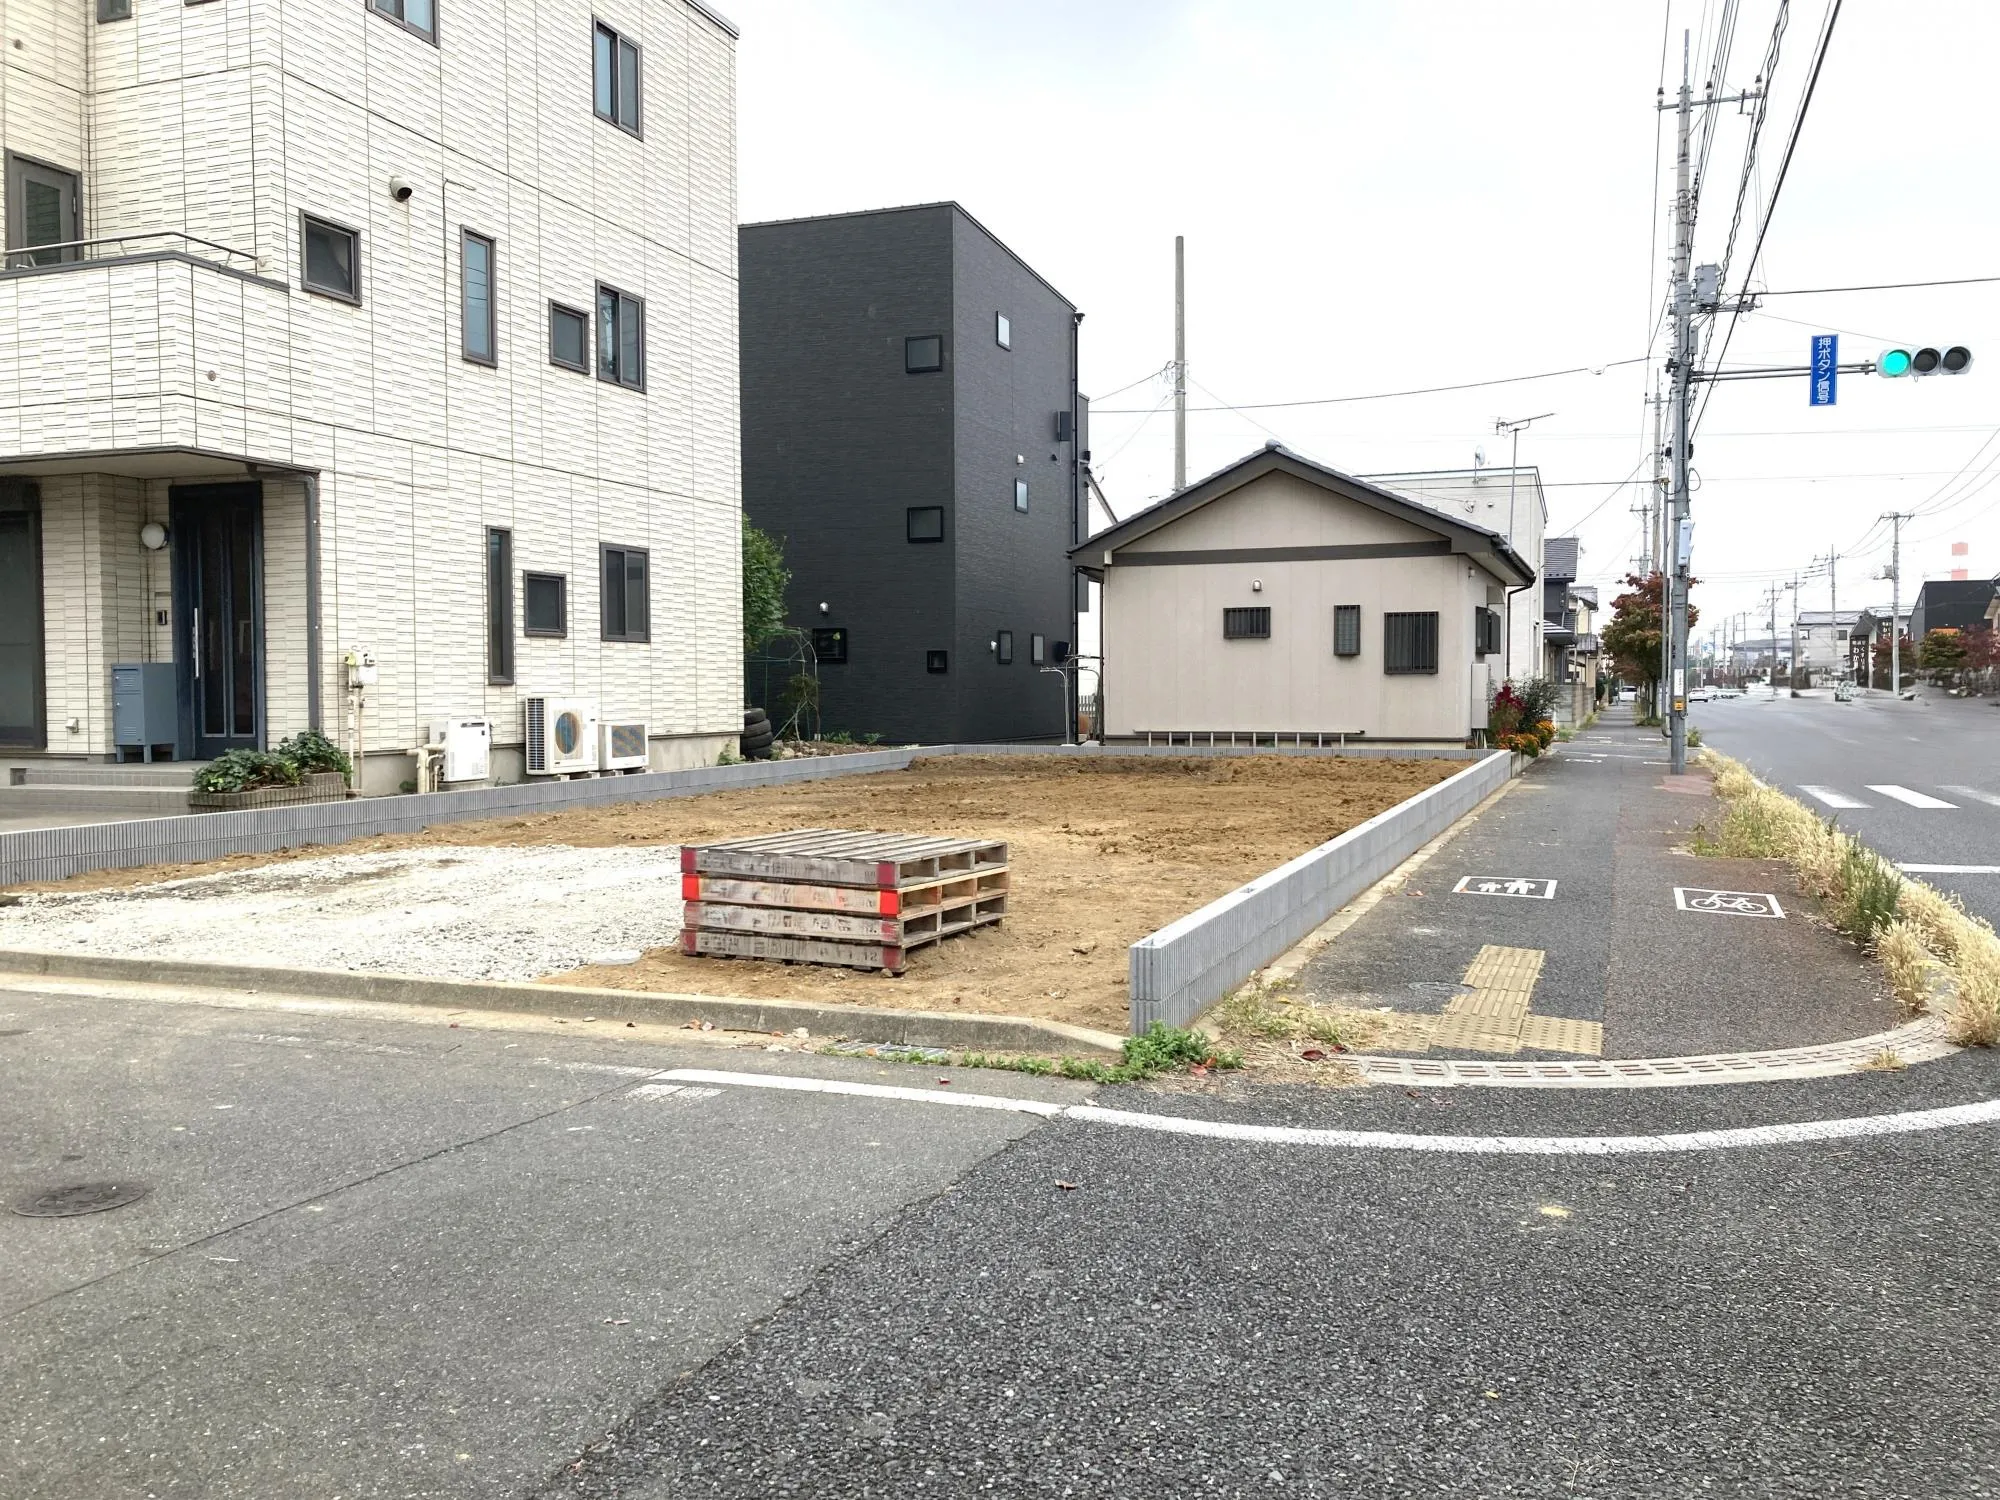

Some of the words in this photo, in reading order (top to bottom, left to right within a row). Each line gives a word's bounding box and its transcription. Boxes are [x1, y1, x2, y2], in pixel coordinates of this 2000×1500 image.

[1817, 337, 1831, 404] 押ボタン信号
